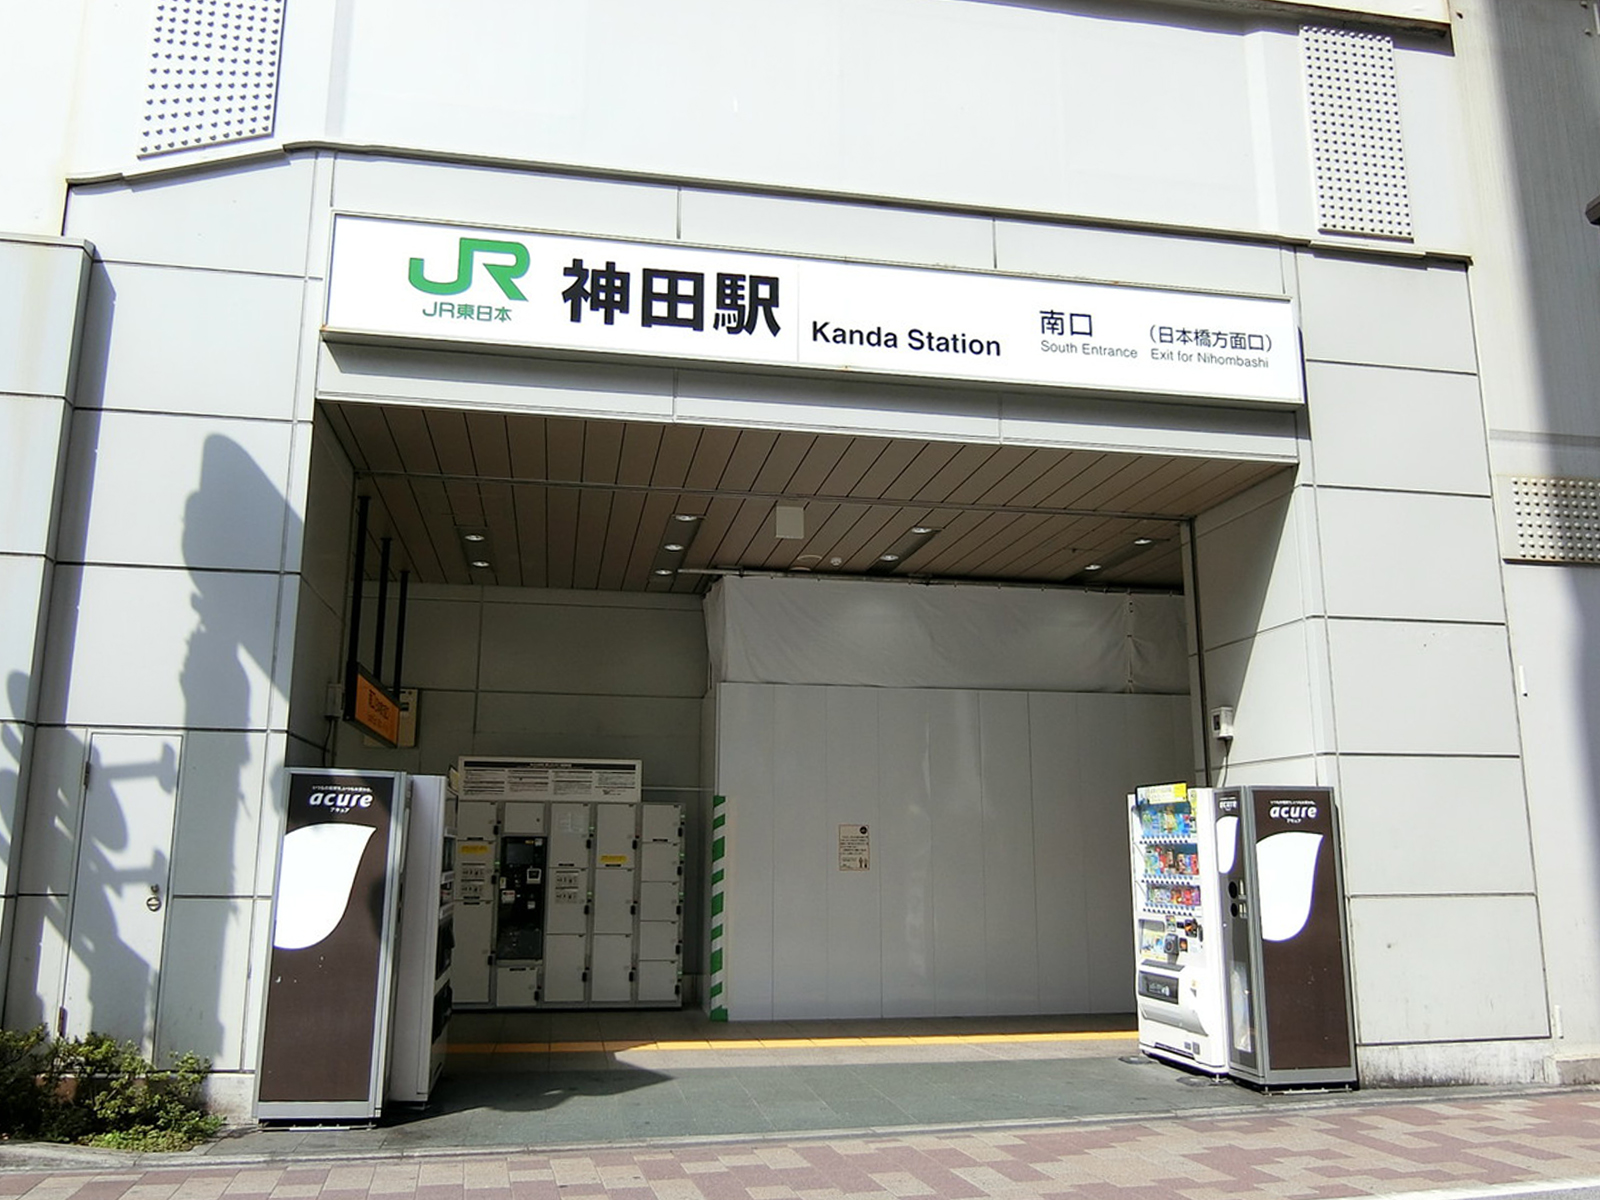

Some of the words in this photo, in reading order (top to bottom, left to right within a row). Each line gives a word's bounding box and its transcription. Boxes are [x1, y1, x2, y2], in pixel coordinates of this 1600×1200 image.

[408, 237, 531, 302] JR
[561, 258, 781, 338] 神田駅
[422, 301, 512, 323] JR東日本
[1039, 309, 1094, 338] 南口
[812, 320, 898, 349] Kanda
[907, 328, 1001, 357] Station
[1040, 339, 1078, 354] South
[1081, 342, 1138, 359] Entrance
[1150, 343, 1174, 361] Exit
[1177, 350, 1194, 363] for
[1197, 352, 1269, 369] Nihombashi
[309, 792, 373, 808] acure
[1269, 806, 1318, 819] acure
